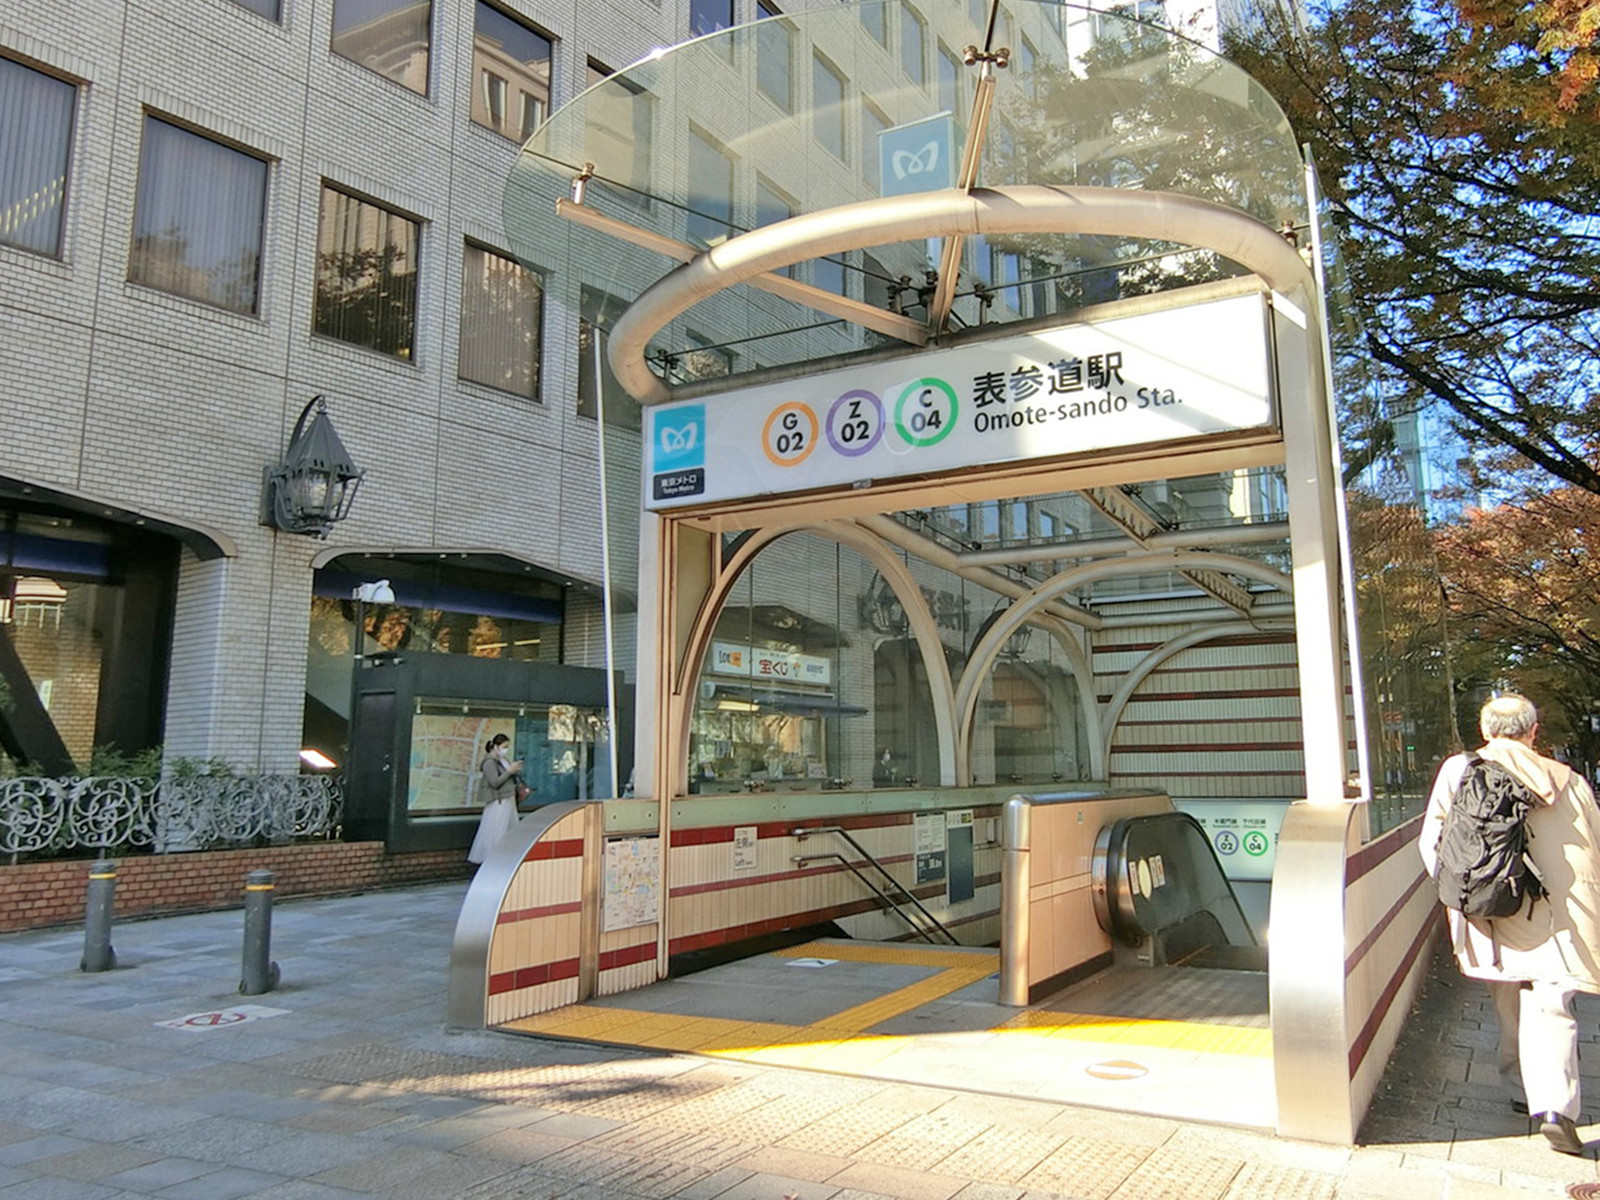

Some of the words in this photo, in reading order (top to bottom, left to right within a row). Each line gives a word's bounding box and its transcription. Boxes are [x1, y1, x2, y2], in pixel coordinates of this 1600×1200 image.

[973, 352, 1125, 408] 表参道駅
[919, 389, 932, 408] C
[849, 401, 862, 419] Z
[974, 391, 1127, 433] Omote-sando
[1137, 387, 1183, 409] Sta.
[783, 412, 798, 430] G
[911, 410, 942, 432] 04
[841, 420, 870, 442] 02
[777, 432, 804, 453] 02
[759, 659, 788, 676] 宝くじ
[1220, 842, 1233, 851] 02
[1249, 842, 1262, 851] 04
